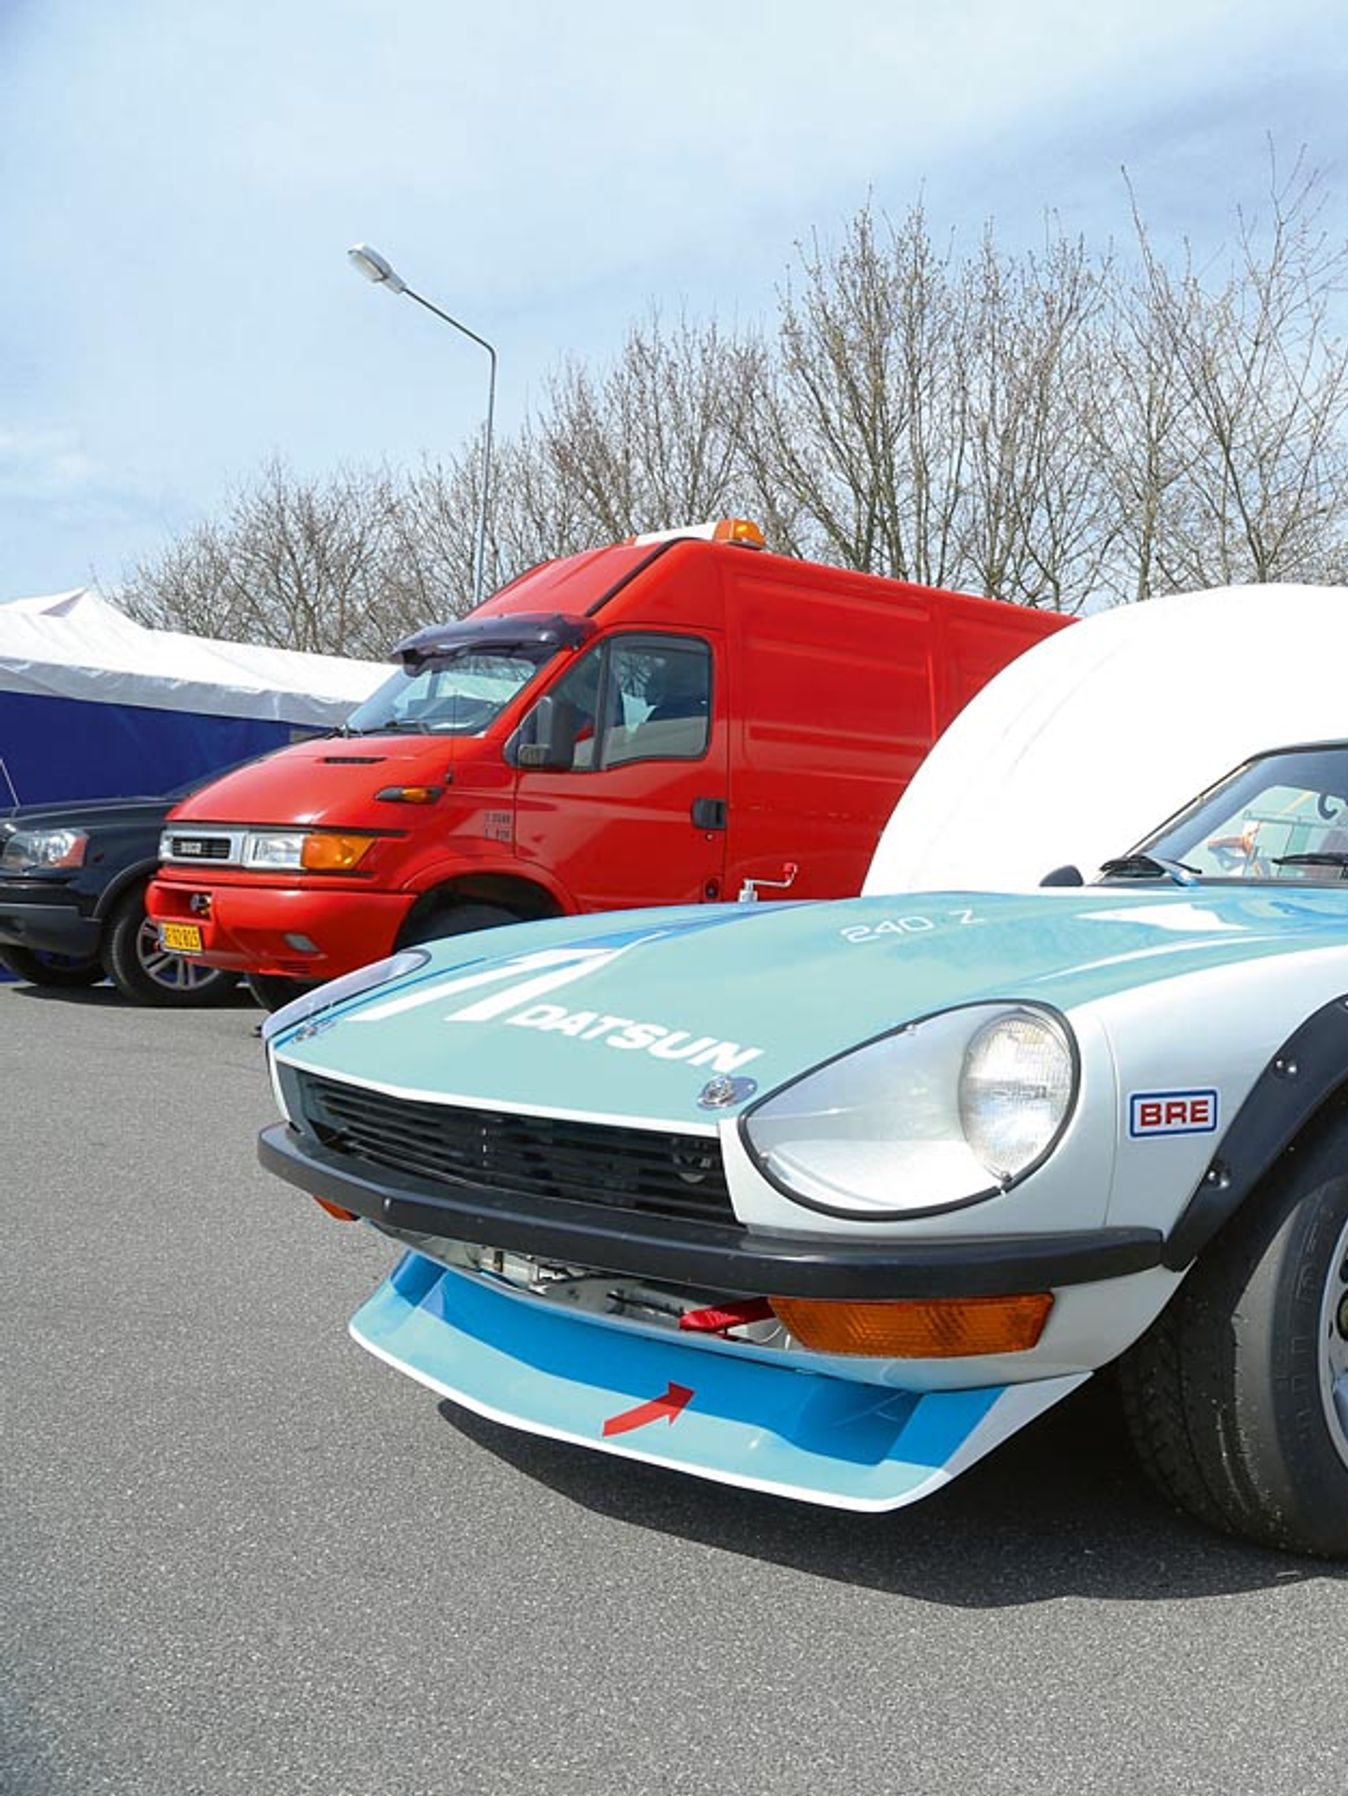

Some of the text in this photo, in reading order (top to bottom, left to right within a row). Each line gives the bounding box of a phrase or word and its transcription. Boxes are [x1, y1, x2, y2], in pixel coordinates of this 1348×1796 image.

[840, 909, 984, 943] 240 Z
[504, 1003, 766, 1074] DATSUN
[1140, 1099, 1209, 1127] BRE
